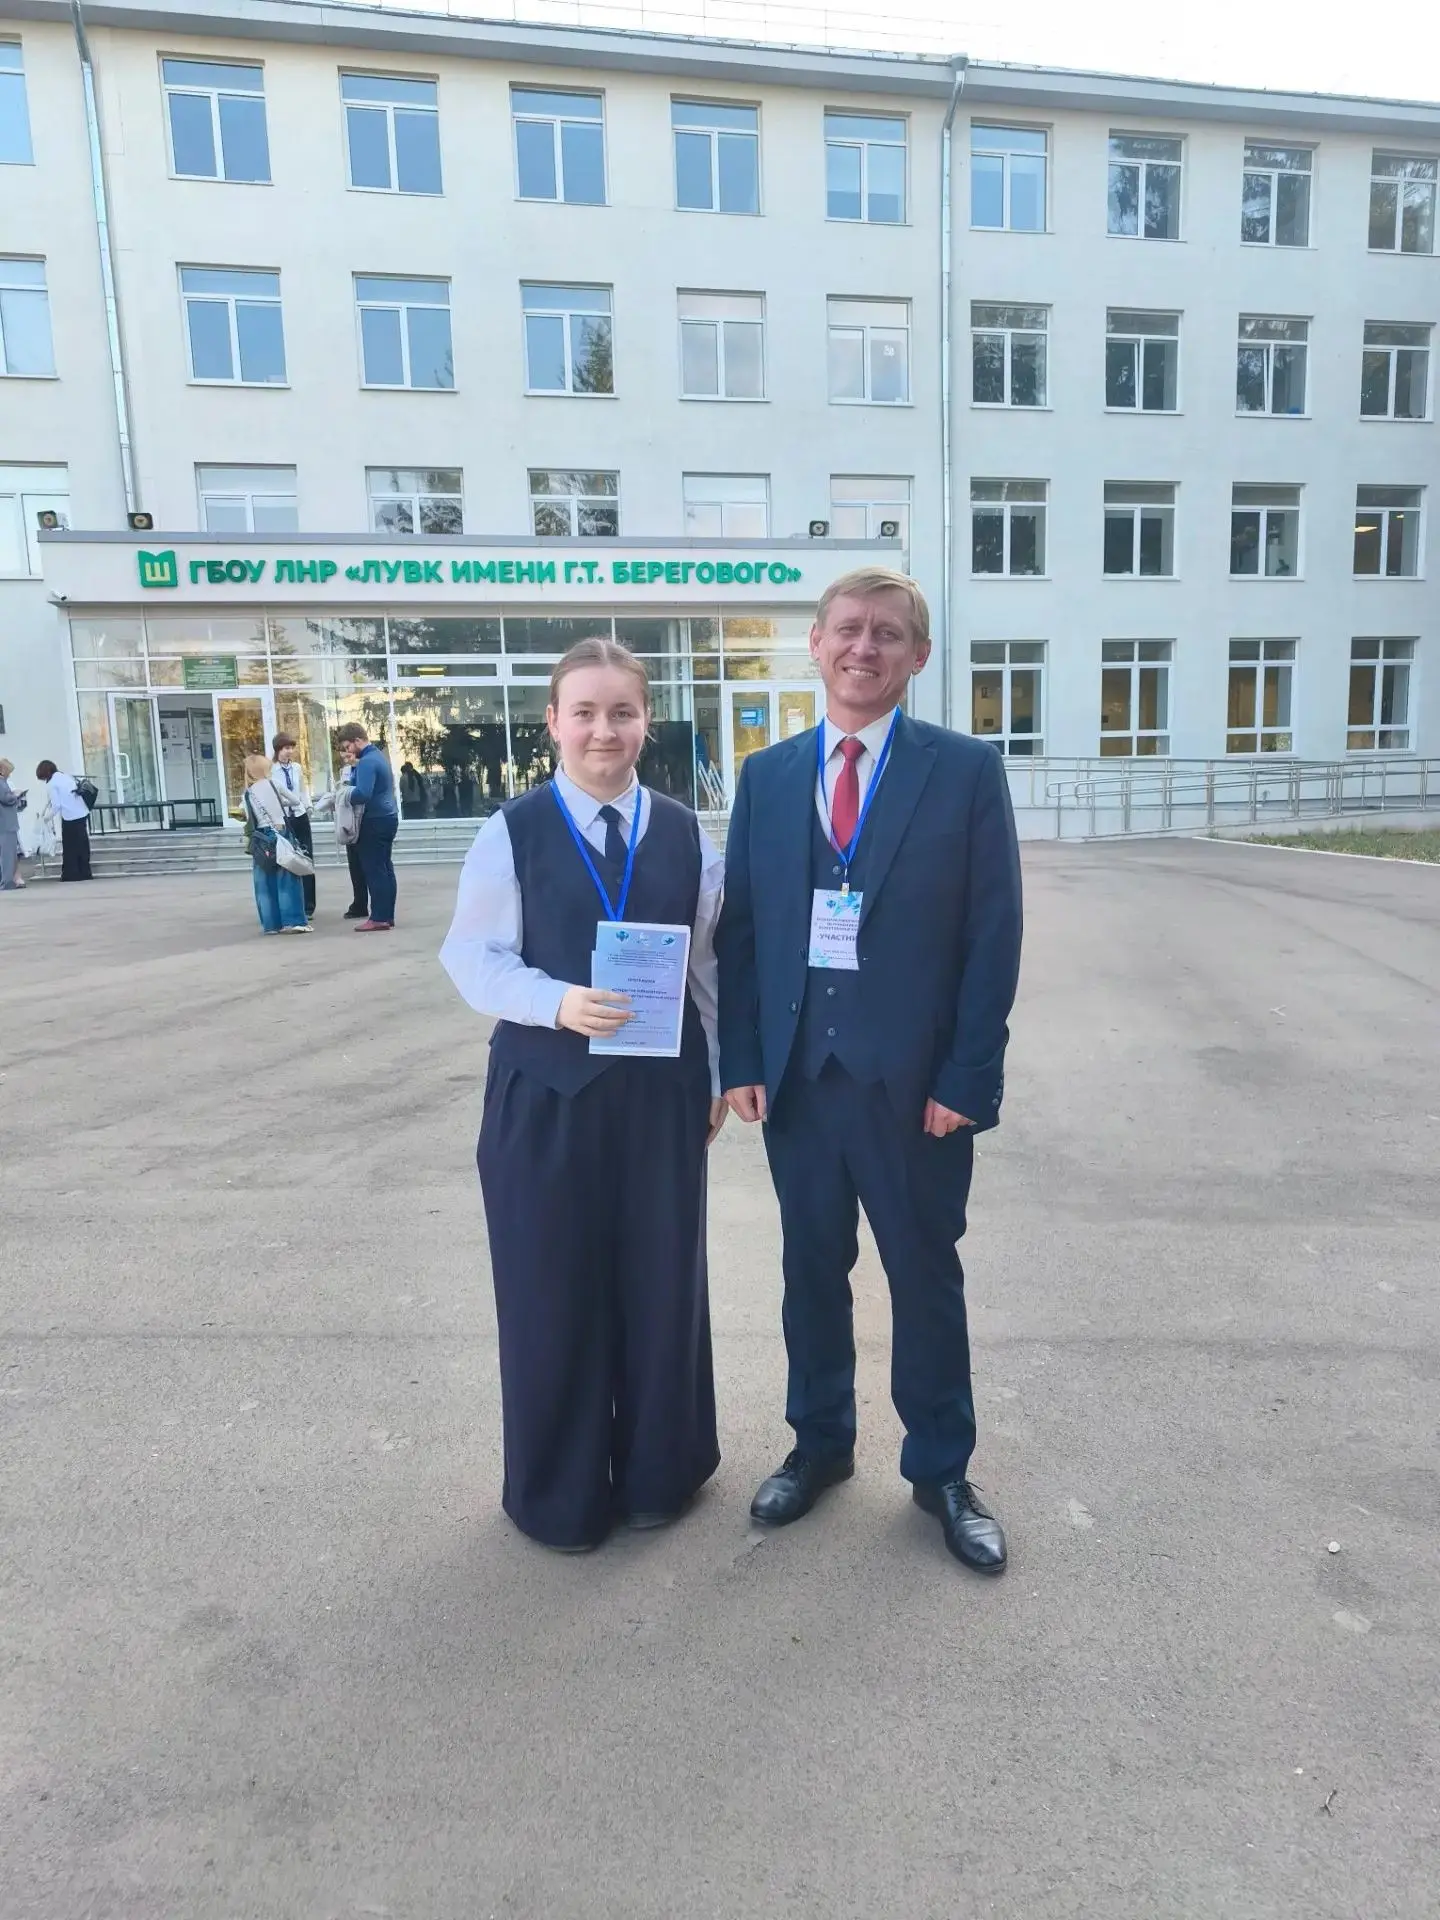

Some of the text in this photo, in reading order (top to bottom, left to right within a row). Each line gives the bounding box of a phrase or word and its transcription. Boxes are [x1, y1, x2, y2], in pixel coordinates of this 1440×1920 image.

[189, 559, 802, 584] ГБОУ ЛНР «ЛУВК ИМЕНИ Г.Т. БЕРЕГОВОГО»
